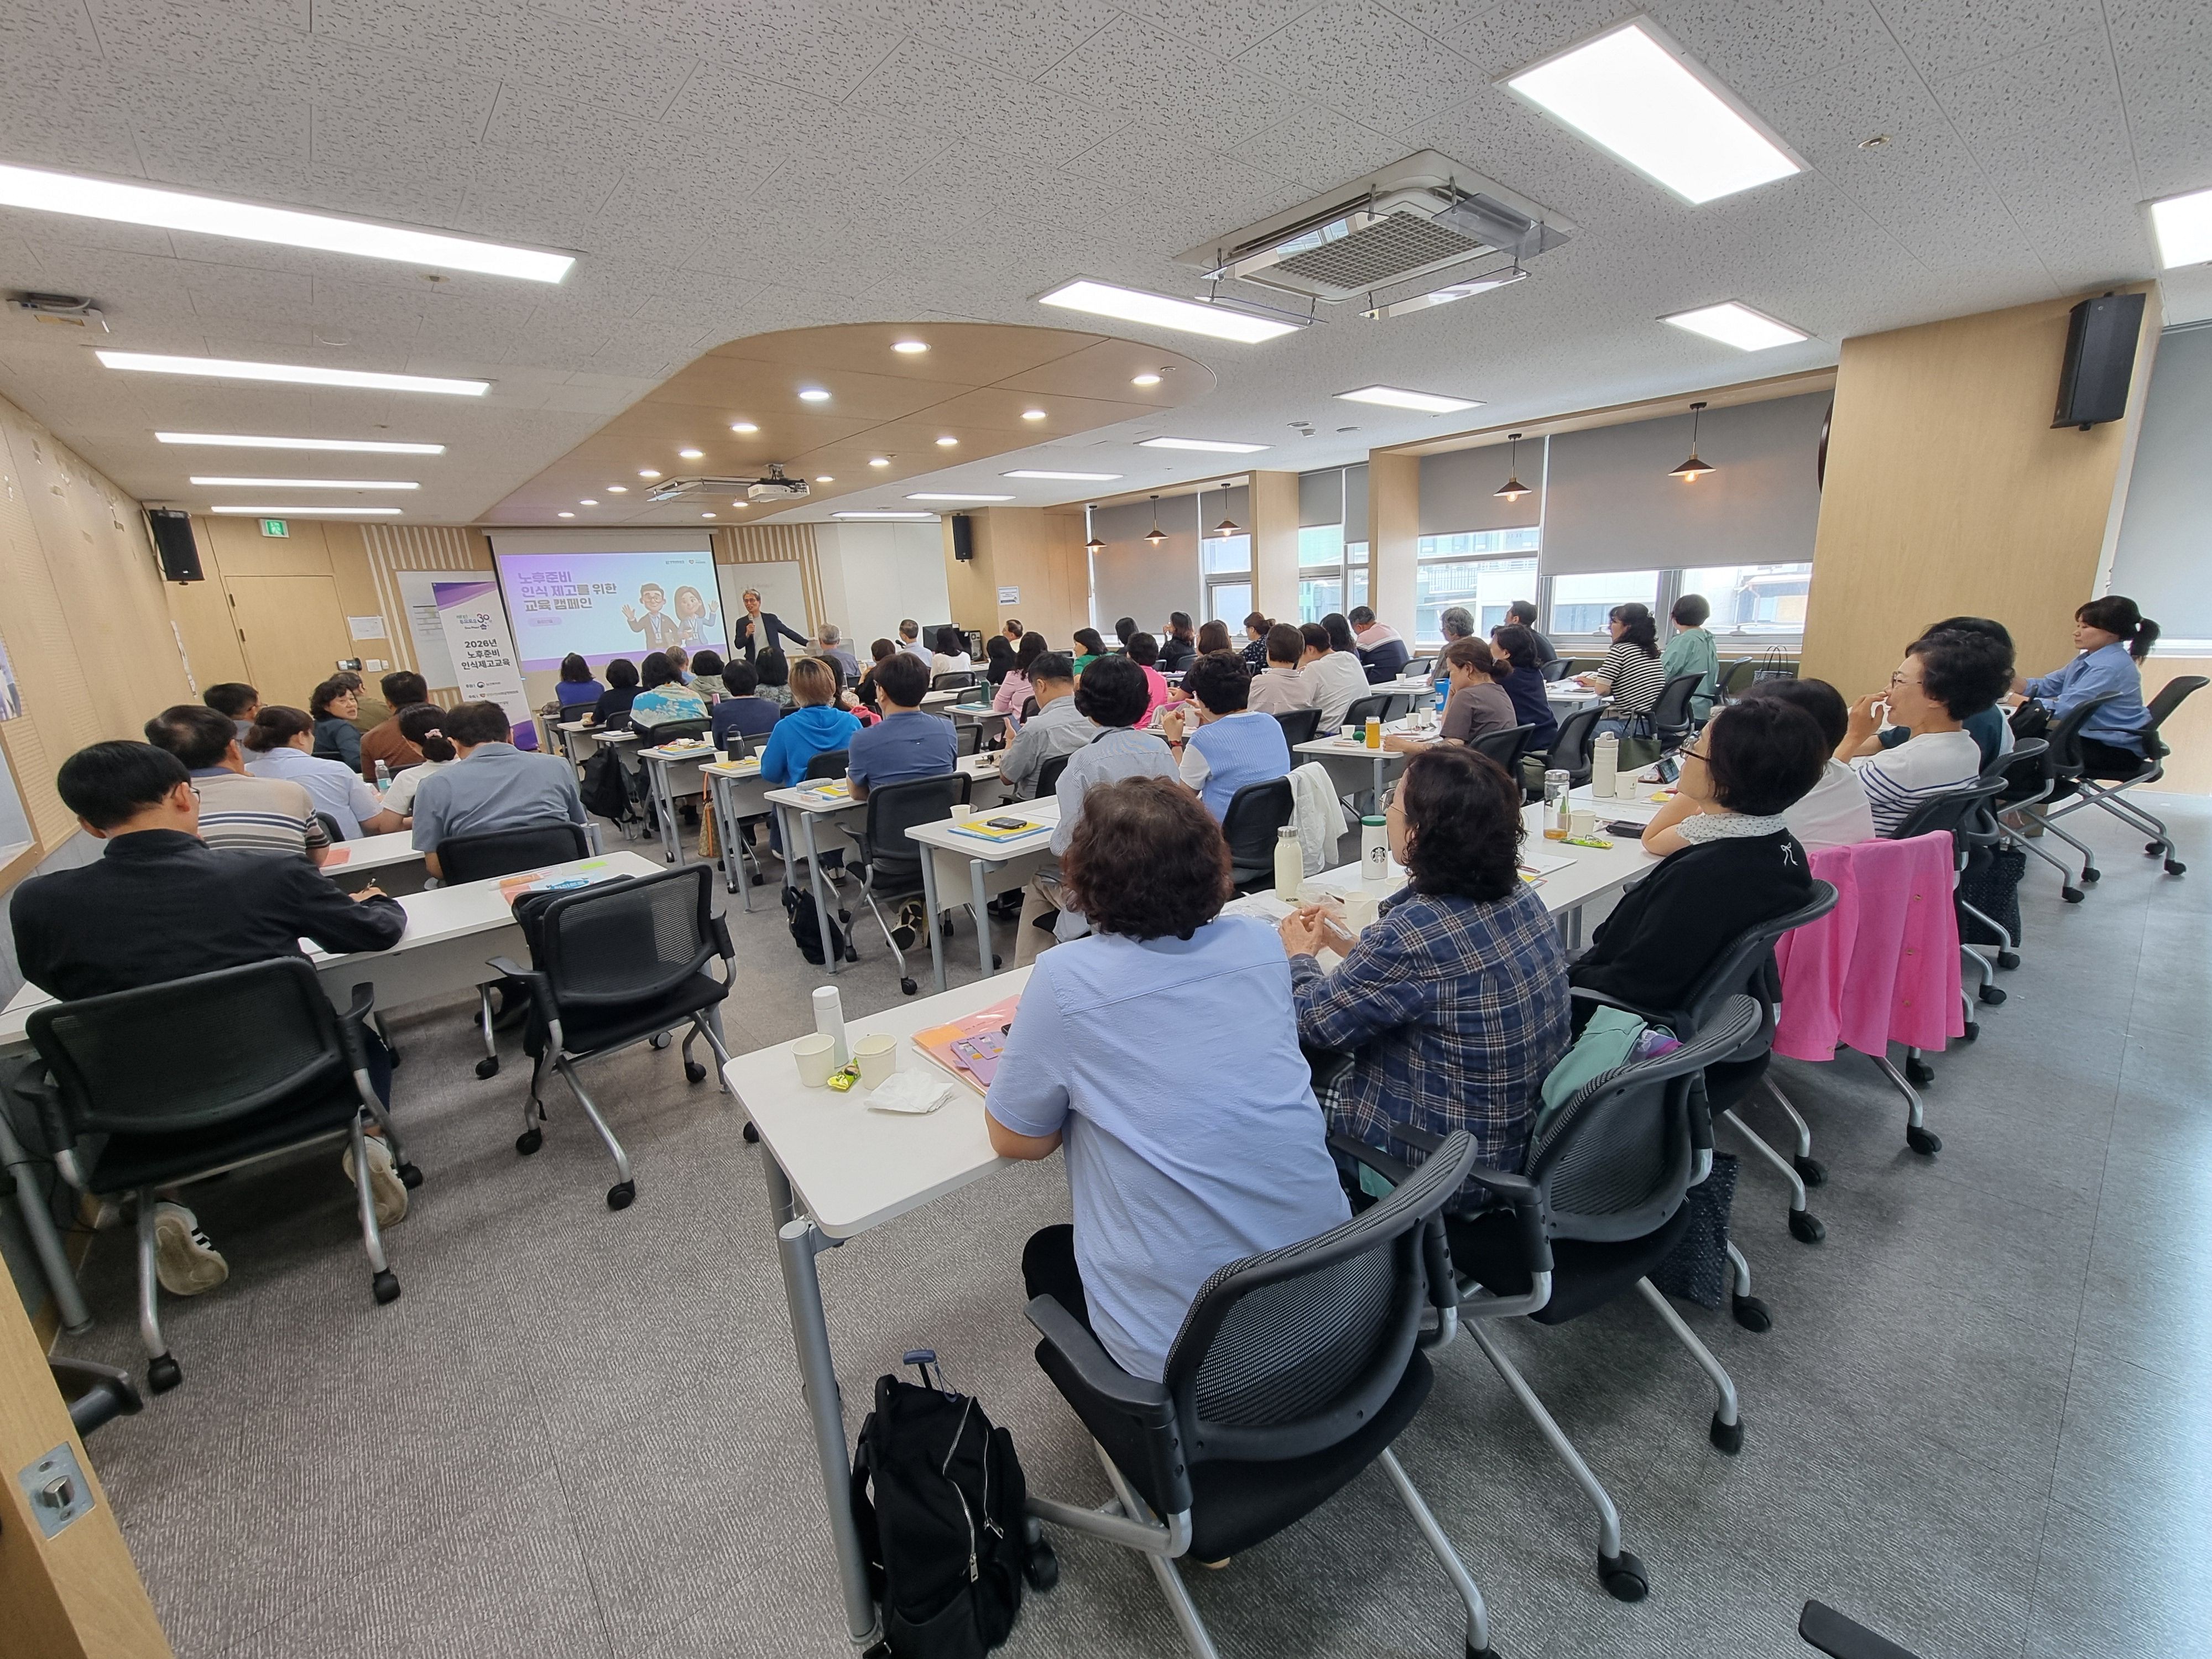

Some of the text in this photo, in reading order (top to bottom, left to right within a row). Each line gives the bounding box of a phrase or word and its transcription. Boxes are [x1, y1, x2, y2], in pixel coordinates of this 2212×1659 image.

[518, 571, 572, 584] 노후준비
[521, 583, 617, 598] 인식 제고를 위한
[524, 597, 593, 612] 교육 캠페인
[465, 639, 497, 648] 2026년
[467, 649, 500, 659] 노후준비
[461, 658, 510, 670] 인식제고교육
